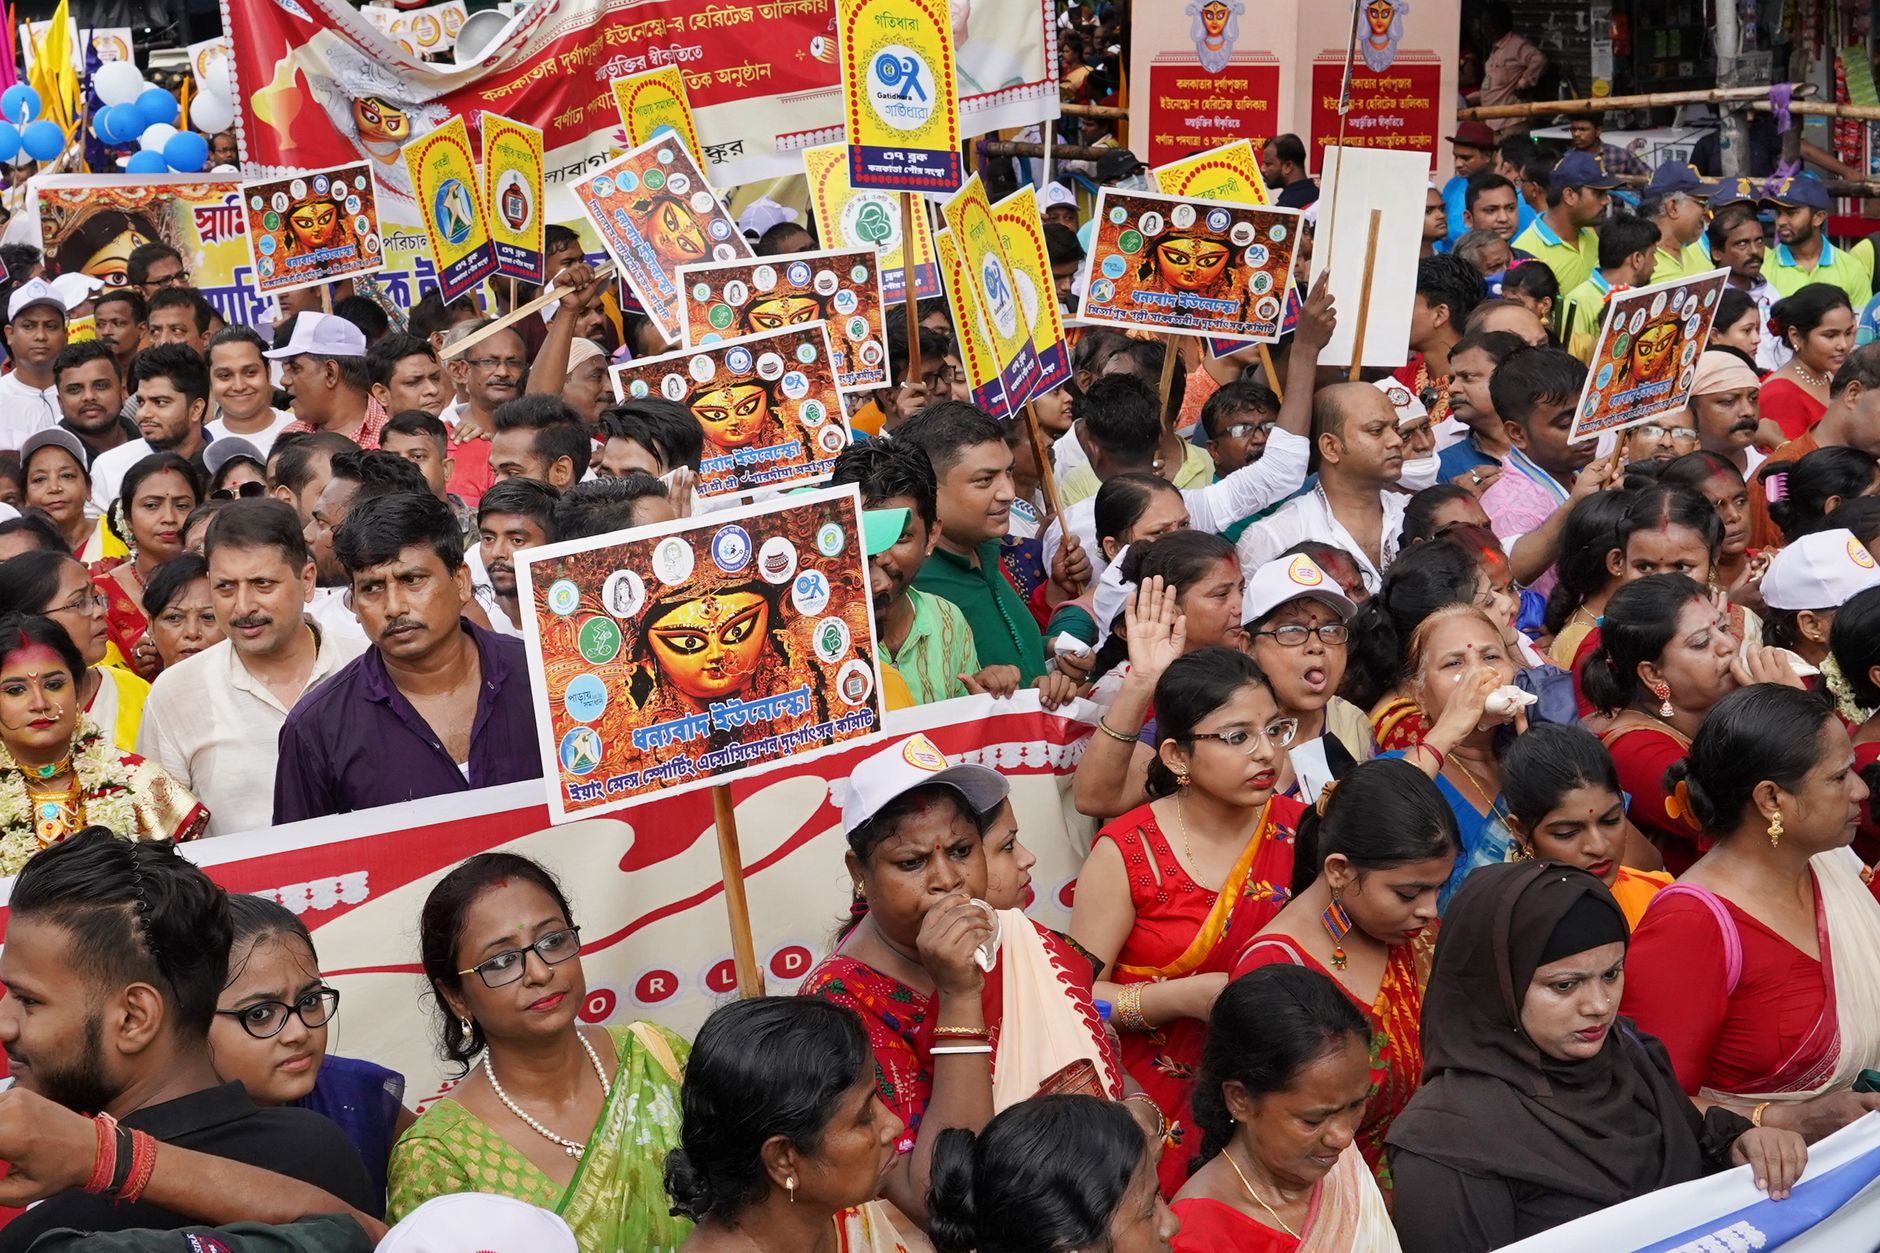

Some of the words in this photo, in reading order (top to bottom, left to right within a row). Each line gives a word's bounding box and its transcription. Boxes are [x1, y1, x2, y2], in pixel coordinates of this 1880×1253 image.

[875, 12, 919, 32] গতিধারা
[479, 56, 557, 103] কলকাতার
[604, 18, 684, 47] ইউনেস্কো-র
[688, 6, 754, 32] হেরিটেজ
[759, 0, 829, 22] তালিকায়
[648, 44, 704, 67] স্বীকৃতিতে
[553, 104, 584, 131] বর্ণাঢ্য
[717, 61, 771, 89] অনুষ্ঠান
[877, 91, 912, 101] Gatidhara
[885, 102, 928, 120] গতিধারা
[701, 140, 744, 164] ঙ্কুর
[883, 151, 904, 161] ৩৭
[908, 150, 928, 163] ব্লক
[1131, 290, 1177, 310] ধন্যবাদ
[1178, 292, 1239, 315] ইউনেস্কো
[1244, 321, 1276, 334] কমিটি
[699, 455, 734, 475] ন্যবাদ
[734, 438, 801, 467] ইউনেস্কো
[633, 713, 710, 751] ধন্যবাদ
[710, 685, 811, 732] ইউনেস্কো
[569, 780, 605, 802] ইয়াং
[606, 770, 640, 794] মেন্স
[642, 755, 697, 787] স্পোর্টিং
[697, 740, 778, 771] এসোসিয়েশন
[779, 719, 835, 755] দুর্গোৎসব
[835, 707, 875, 734] কমিটি
